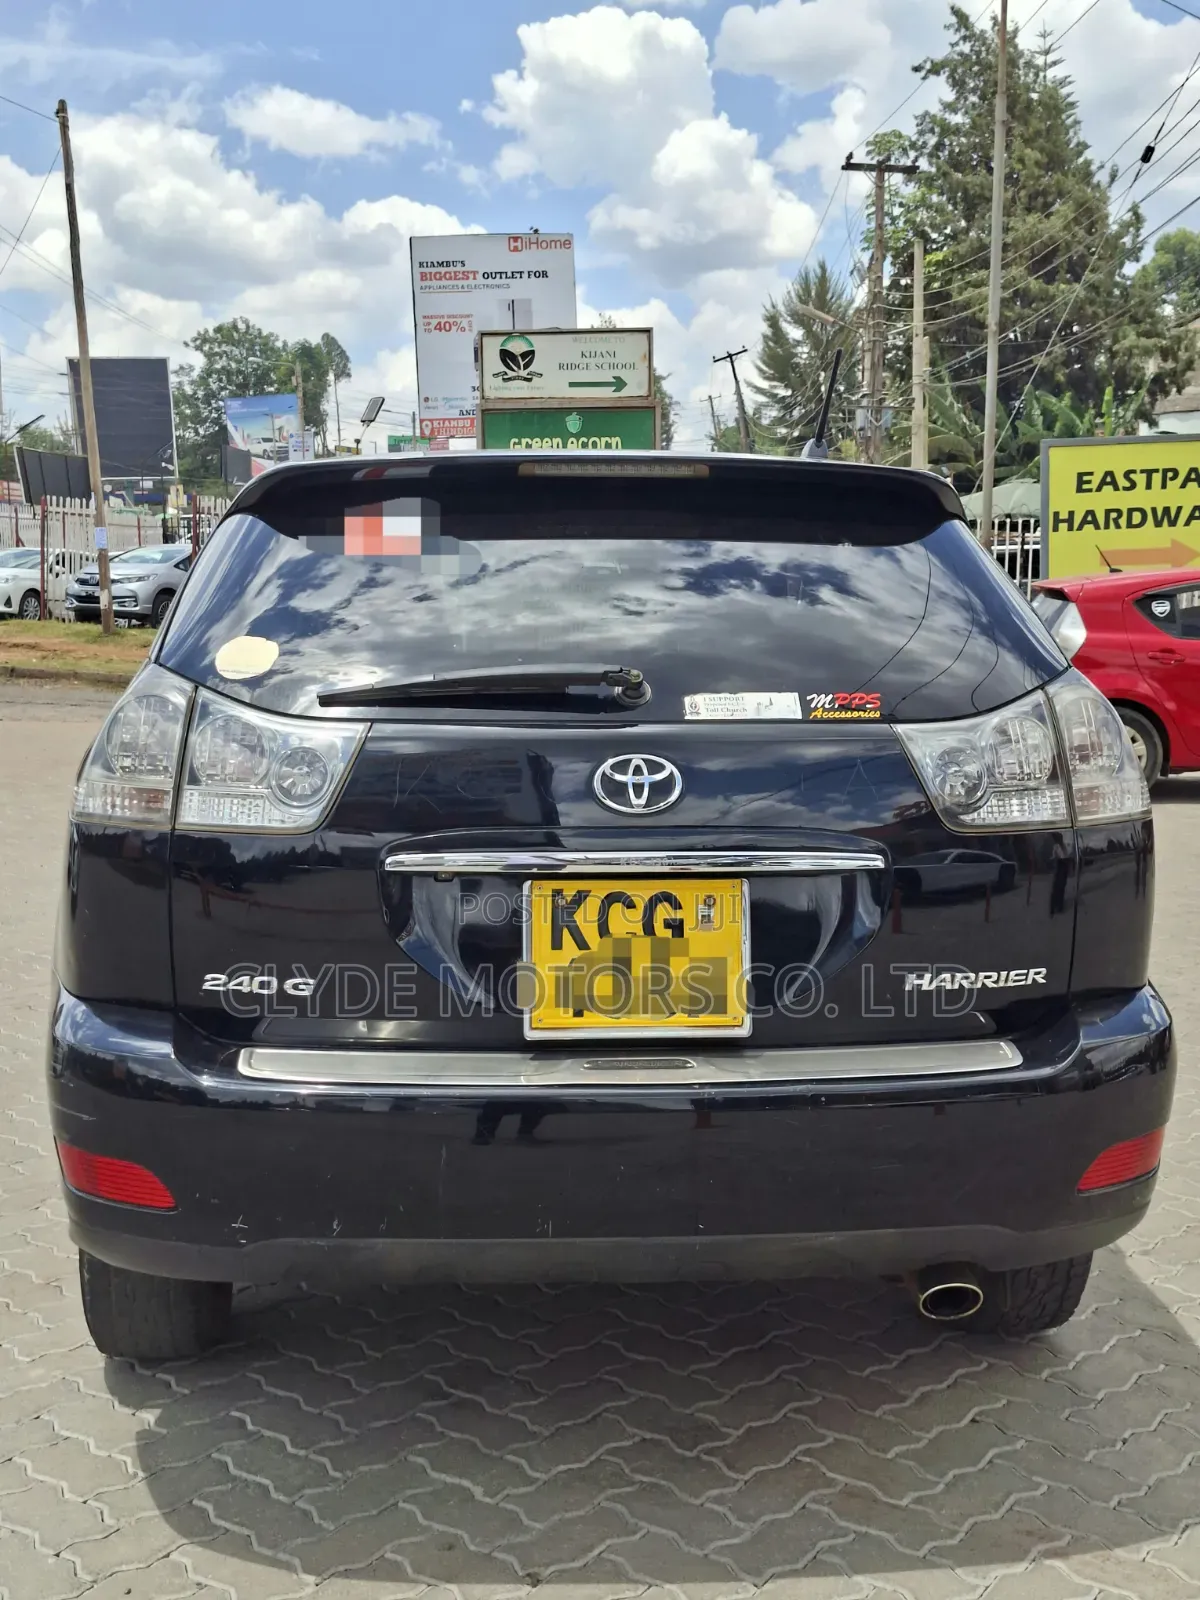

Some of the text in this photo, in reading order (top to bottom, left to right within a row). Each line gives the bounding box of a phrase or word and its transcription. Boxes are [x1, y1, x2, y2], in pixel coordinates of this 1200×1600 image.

[418, 260, 466, 269] KIAMBU'S
[419, 270, 549, 282] BIGGEST OUTLET FOR
[433, 320, 466, 333] 40%
[572, 336, 613, 344] WELCOME
[580, 350, 616, 359] KIJANI
[558, 361, 639, 371] RIDGE SCHOOL
[432, 420, 471, 428] KIAMBU
[433, 427, 476, 436] THINDIG
[1076, 468, 1200, 494] EASTPA
[1052, 505, 1200, 532] HARDWA
[809, 708, 881, 719] Accessories
[551, 888, 684, 951] KCG
[202, 973, 316, 996] 240 G
[904, 967, 1047, 991] HARRIER
